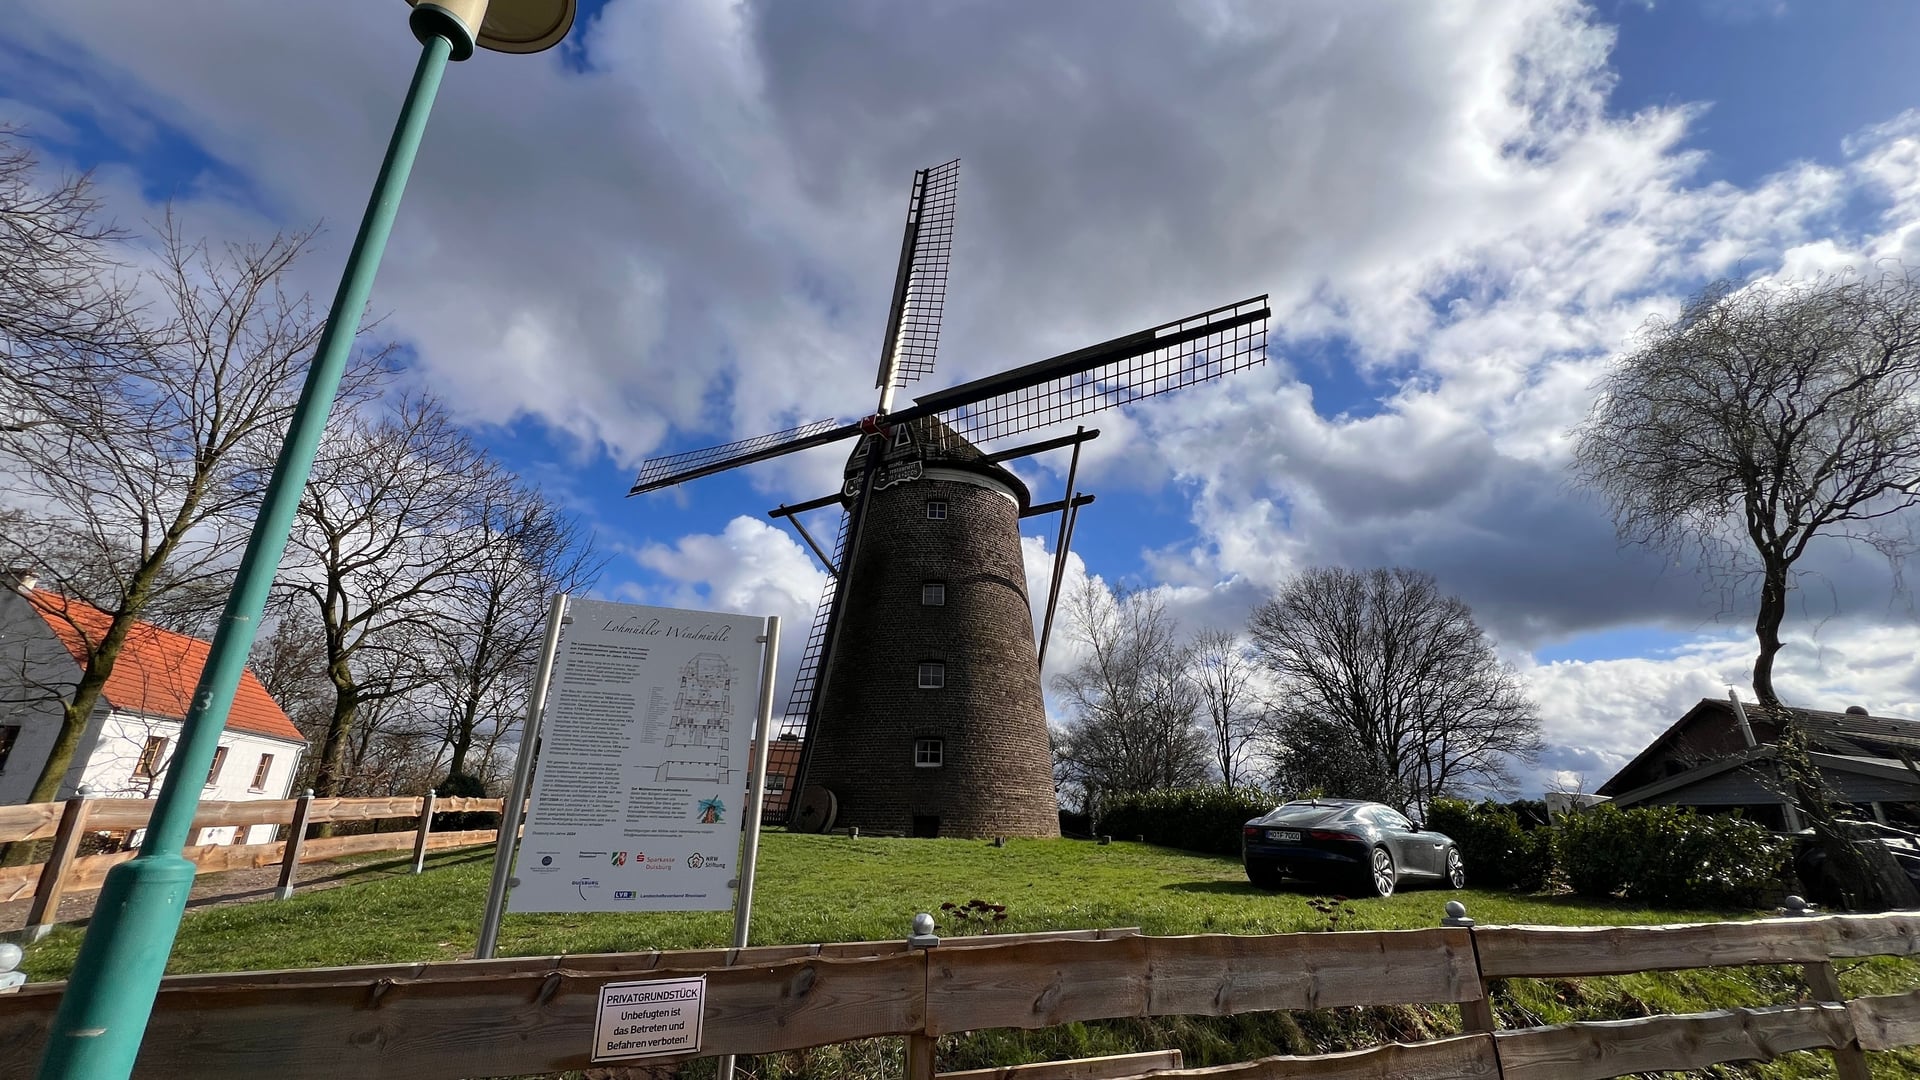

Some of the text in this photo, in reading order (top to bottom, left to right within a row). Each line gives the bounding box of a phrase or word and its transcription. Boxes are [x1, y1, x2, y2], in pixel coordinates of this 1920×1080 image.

[601, 616, 731, 641] Lohmühler Windmühle
[645, 864, 672, 872] Duisburg
[606, 988, 698, 1004] PRIVATGRUNDSTÜCK
[621, 1008, 681, 1020] Unbefugten ist
[614, 1021, 685, 1036] das Betreten und
[607, 1035, 688, 1050] Befahren verboten!
